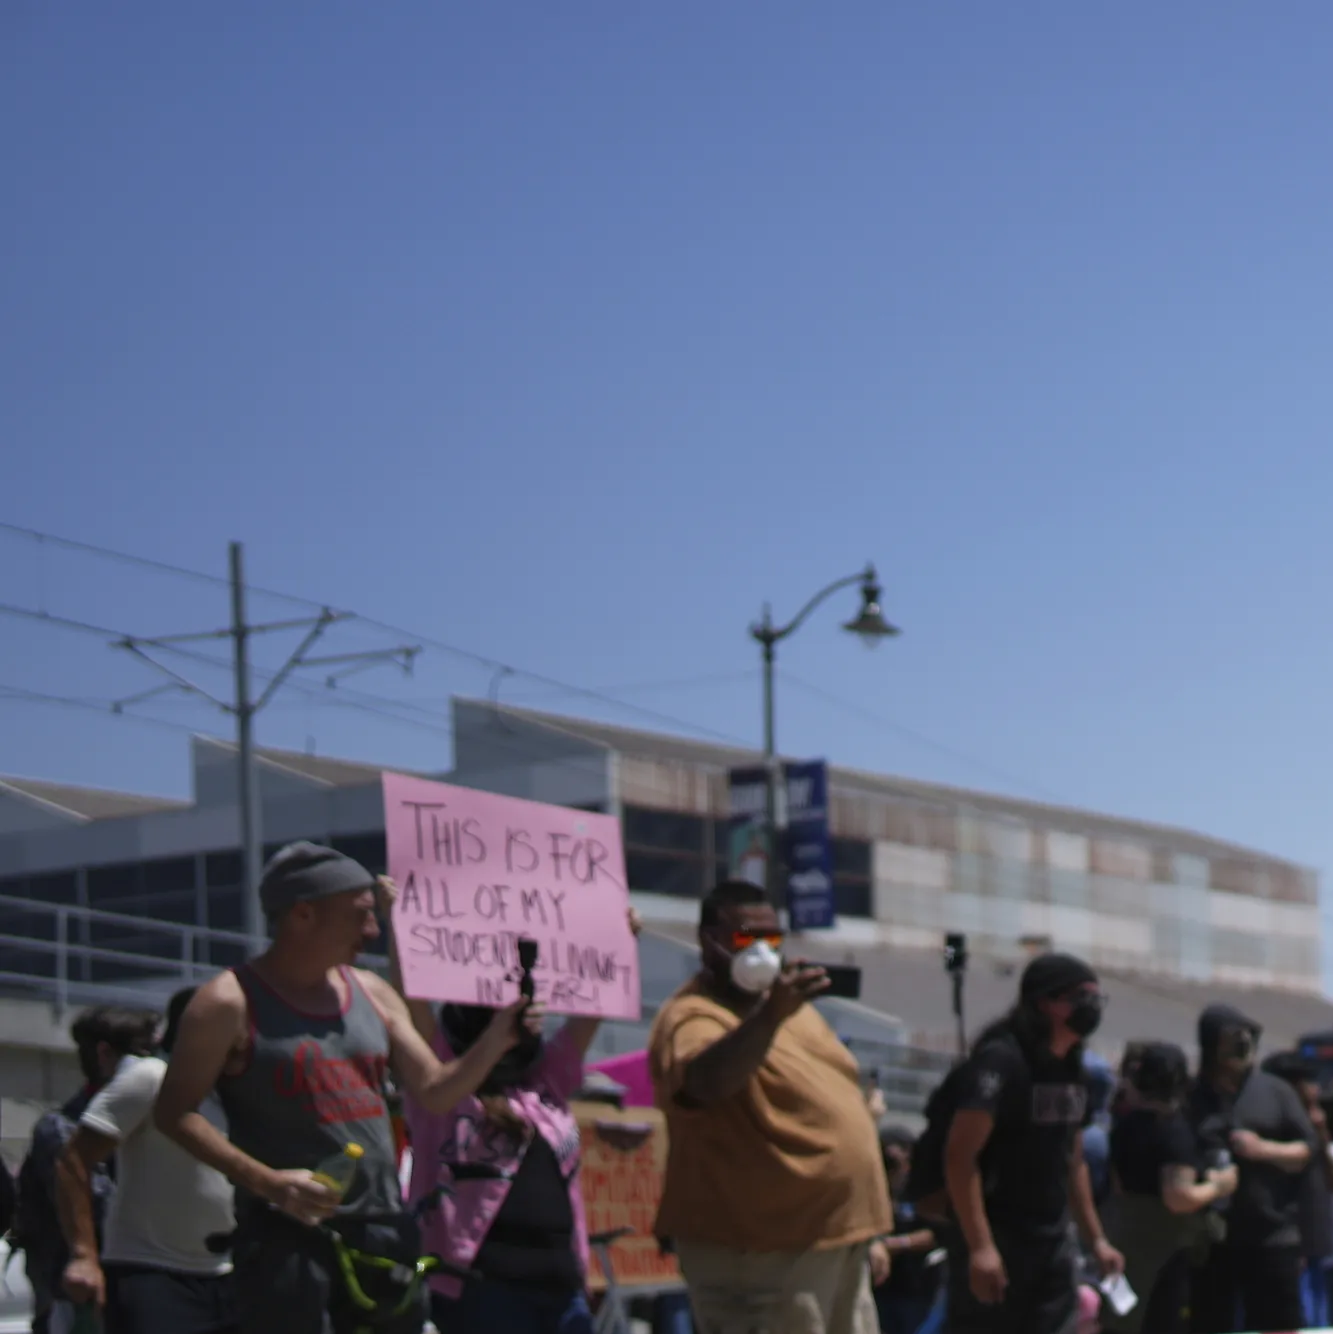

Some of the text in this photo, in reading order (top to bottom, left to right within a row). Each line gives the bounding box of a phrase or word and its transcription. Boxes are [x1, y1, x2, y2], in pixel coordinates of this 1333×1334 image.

[402, 801, 629, 892] THIS IS FOR
[401, 869, 566, 932] ALL OF MY
[407, 923, 547, 970] STUDENT
